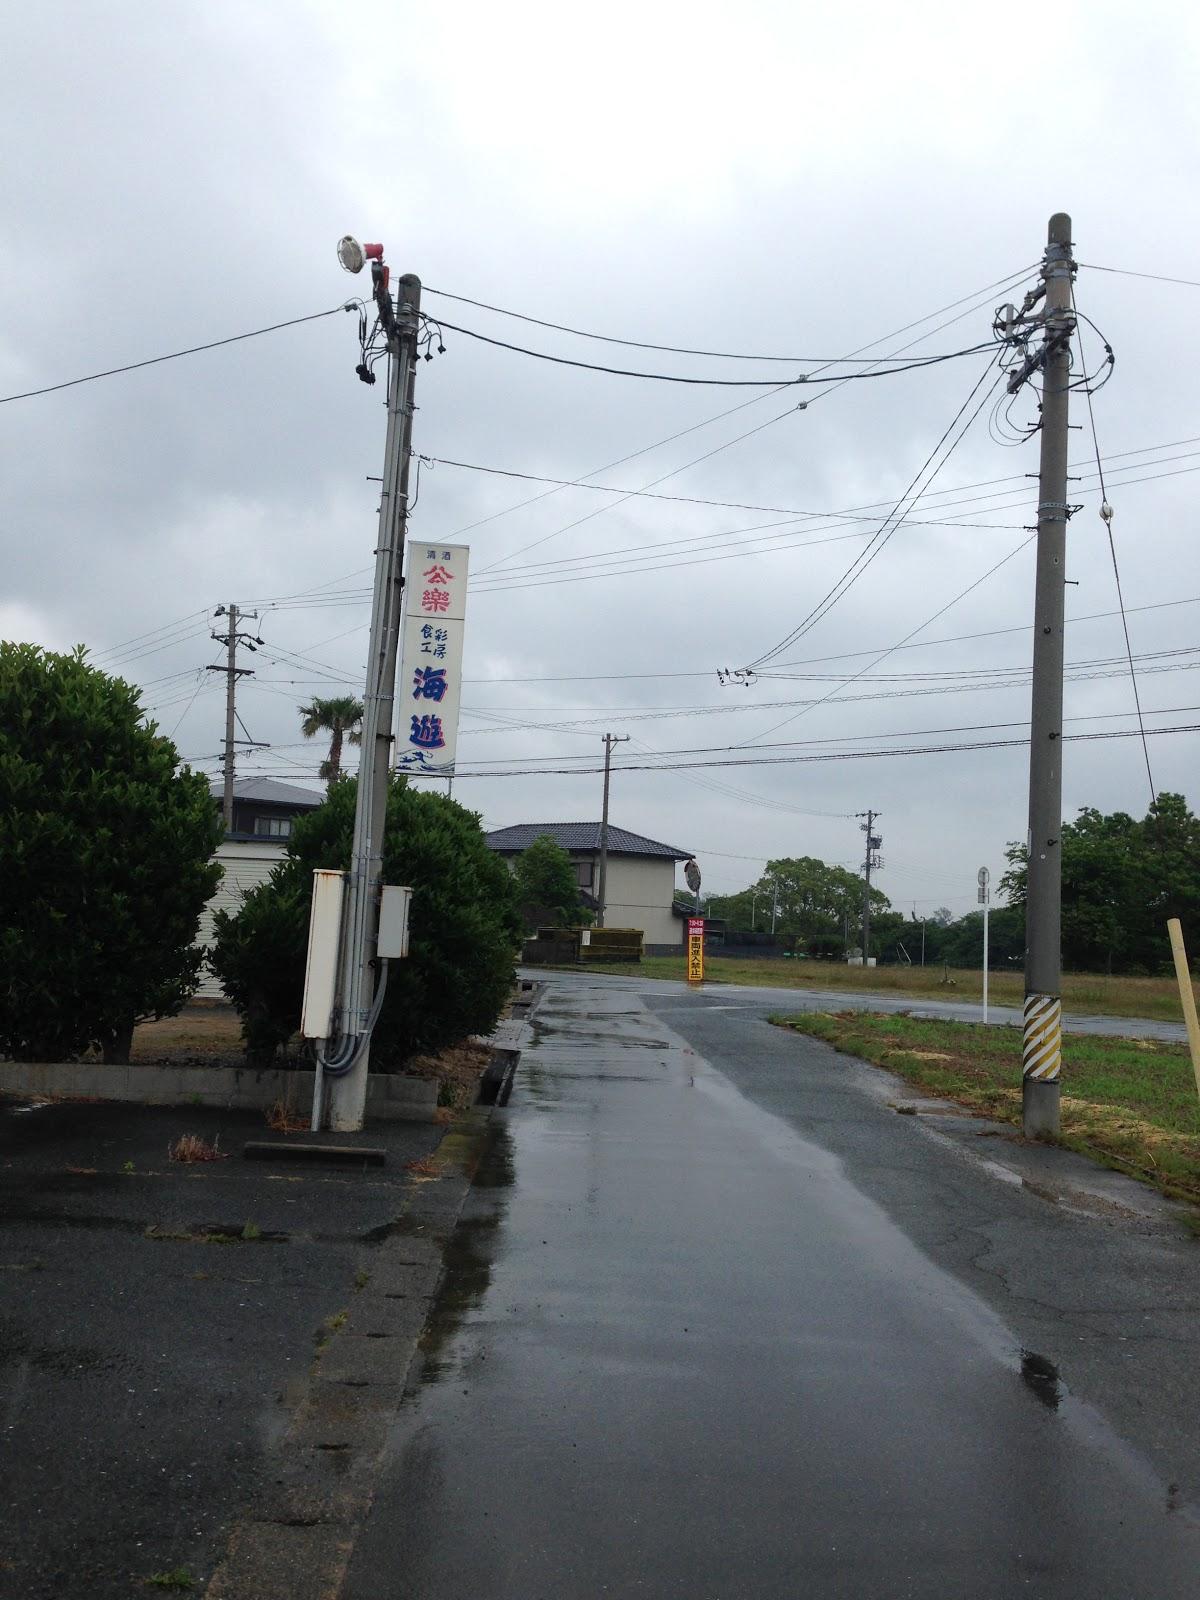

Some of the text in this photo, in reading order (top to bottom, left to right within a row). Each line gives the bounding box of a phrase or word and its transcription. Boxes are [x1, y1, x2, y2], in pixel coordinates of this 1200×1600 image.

[426, 550, 451, 560] 清酒
[421, 623, 448, 641] 食彩
[420, 641, 447, 659] 工房
